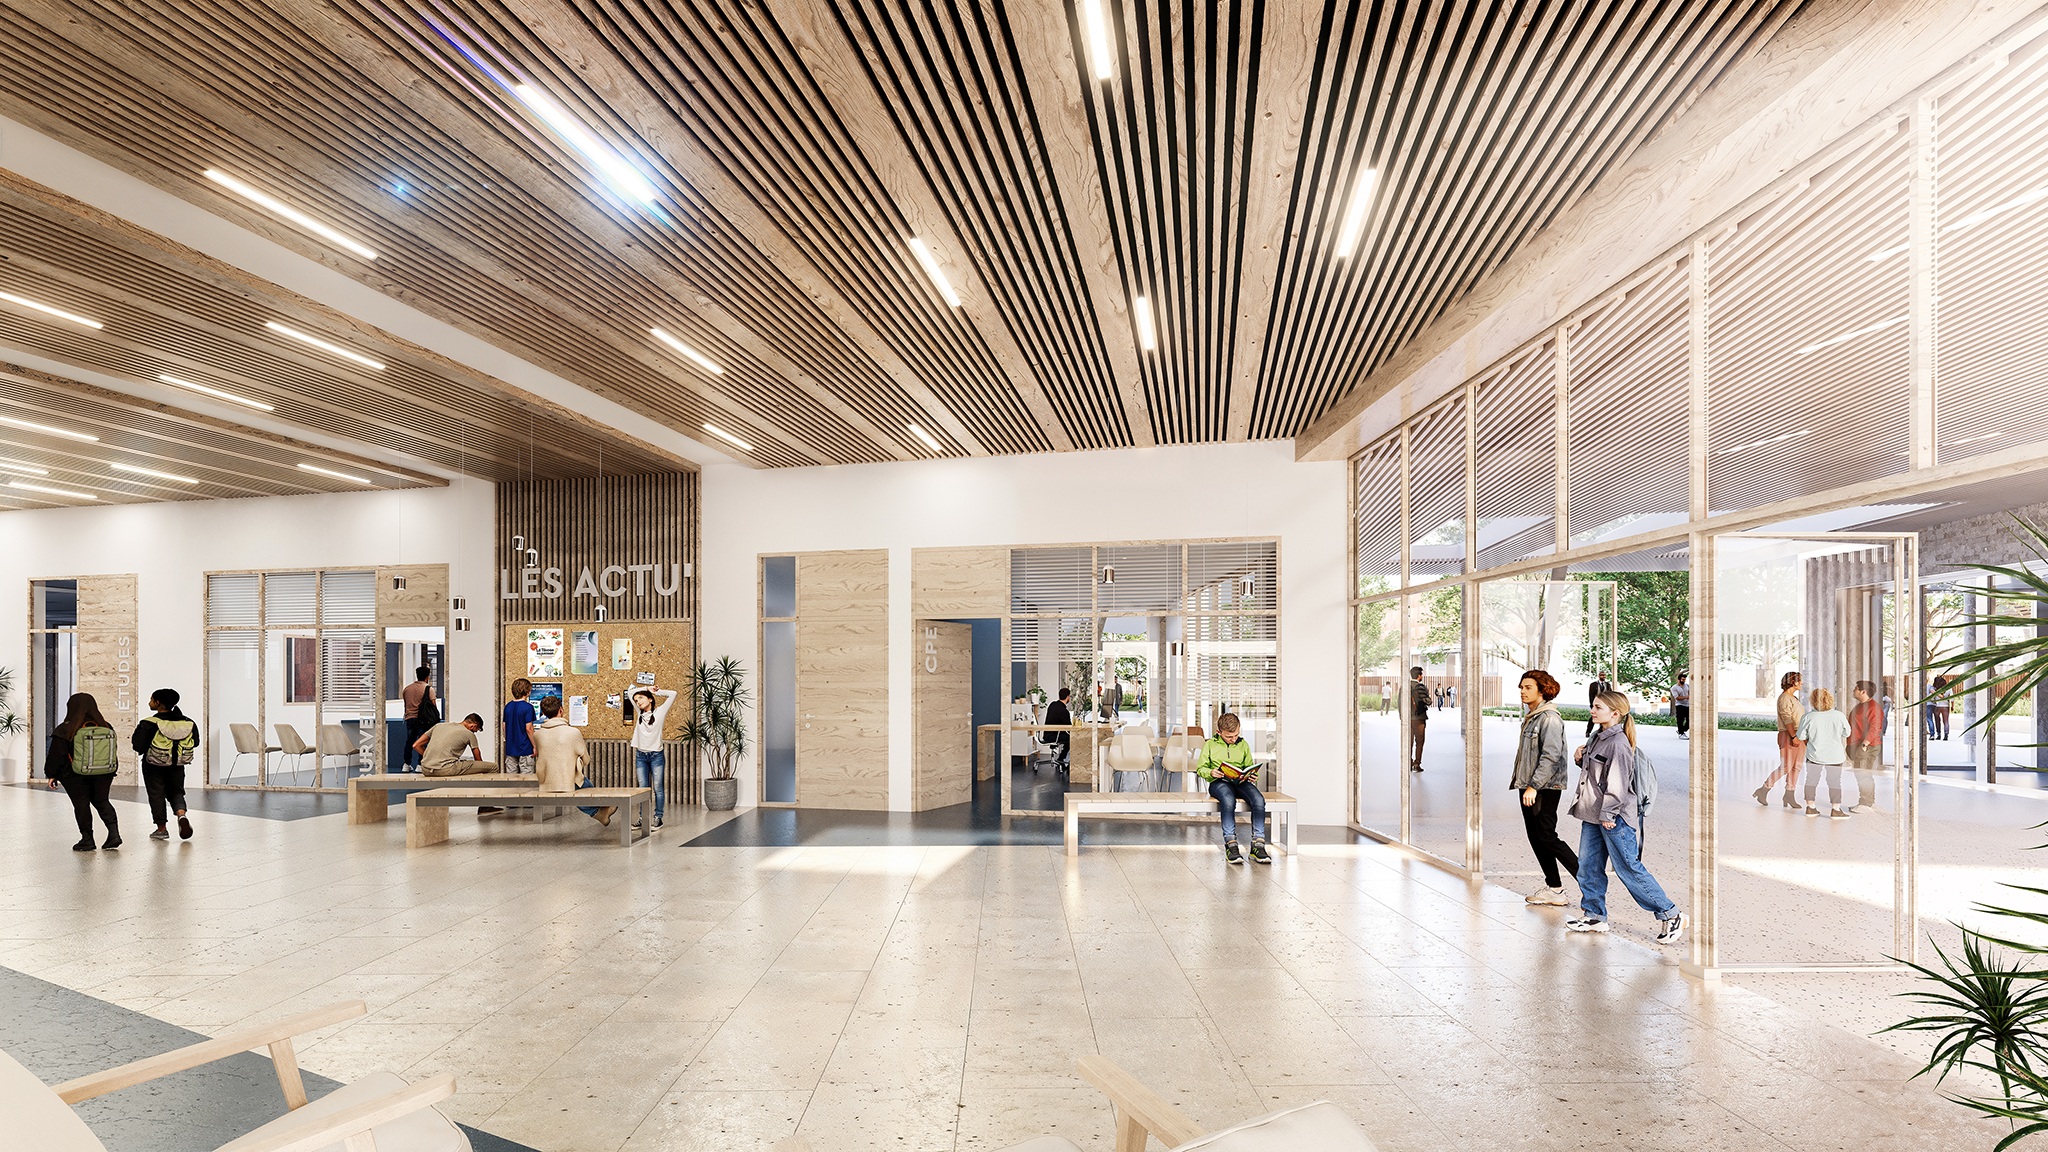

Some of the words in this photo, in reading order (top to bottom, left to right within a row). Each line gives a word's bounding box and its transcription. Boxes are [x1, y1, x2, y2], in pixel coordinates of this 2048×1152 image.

[501, 566, 563, 600] LES
[573, 563, 692, 598] ACTU'
[114, 635, 131, 711] ÉTUDES
[925, 626, 938, 673] CPE
